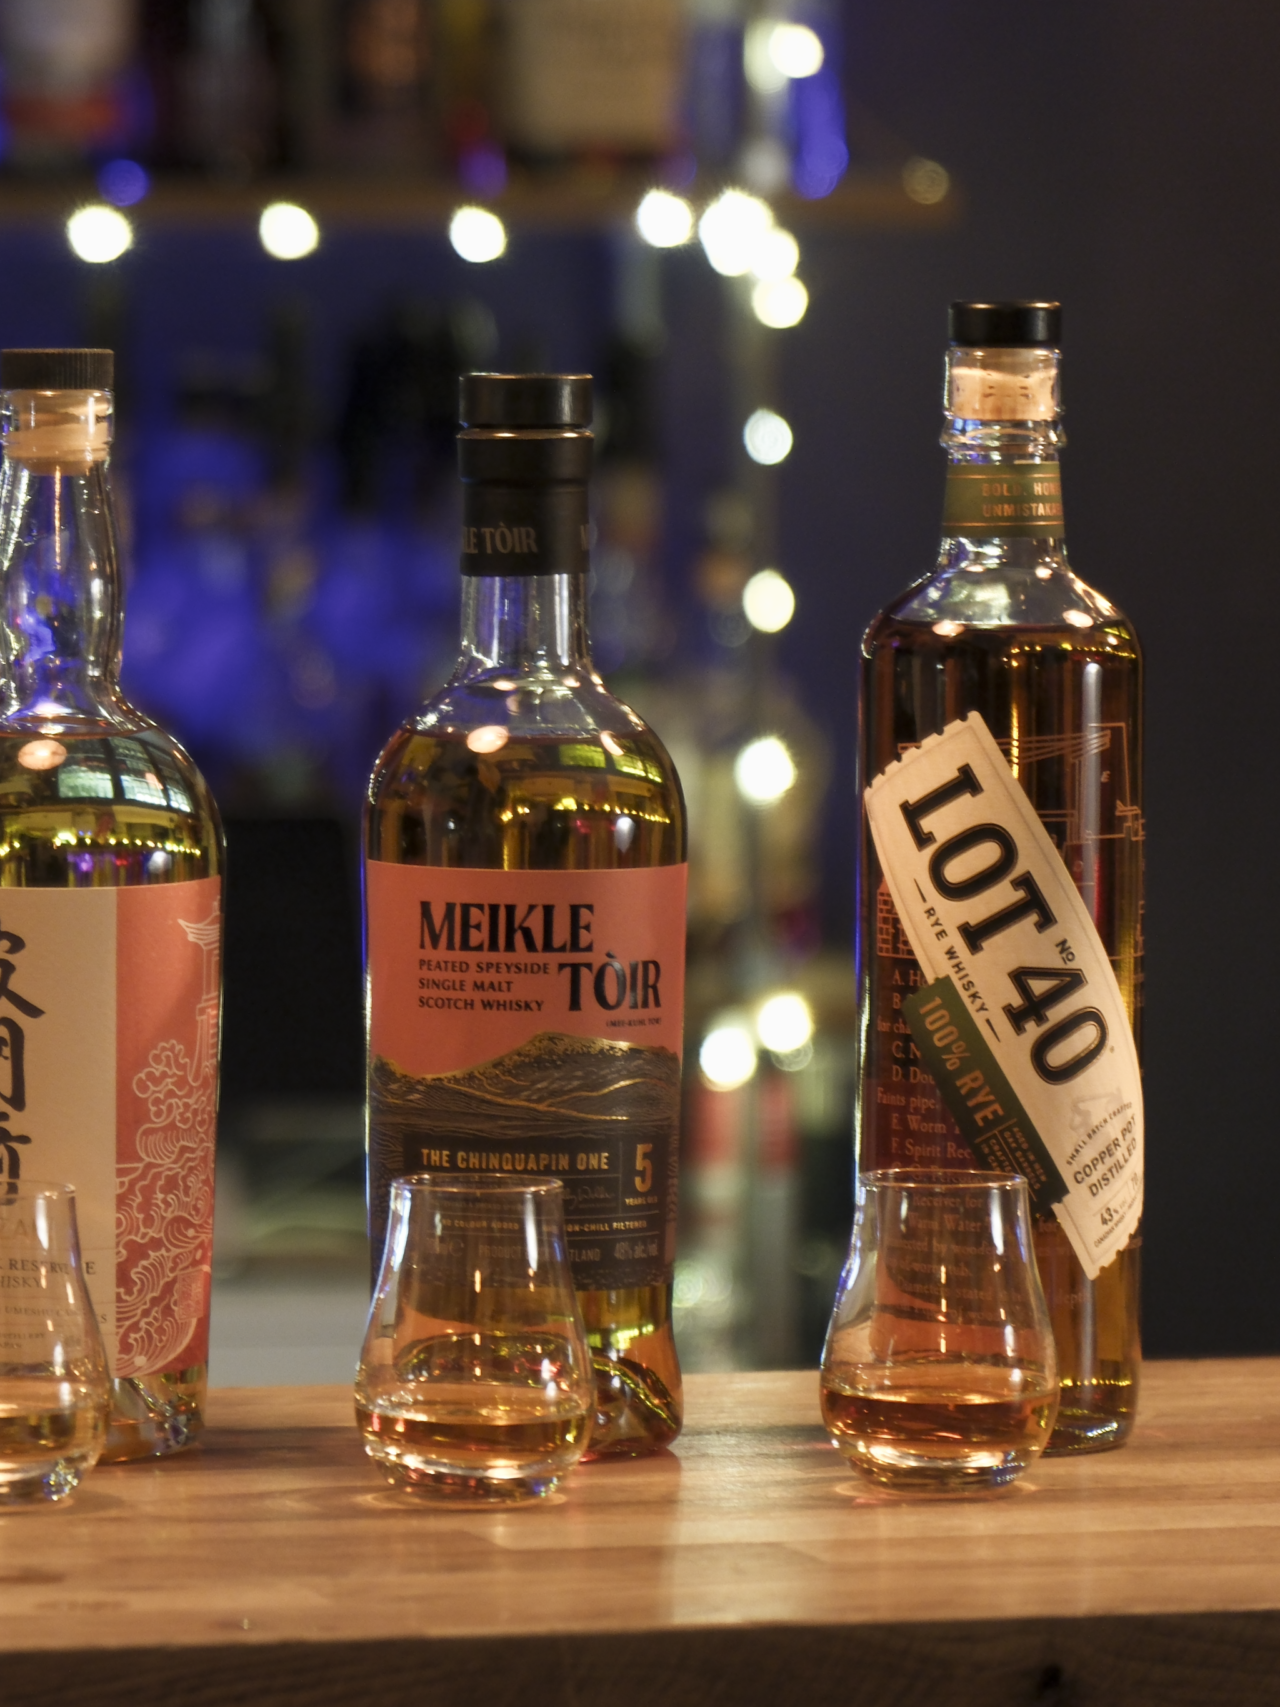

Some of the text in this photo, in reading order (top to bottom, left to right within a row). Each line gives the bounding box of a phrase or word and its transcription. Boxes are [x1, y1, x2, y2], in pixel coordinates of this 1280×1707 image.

[419, 900, 594, 953] MEIKLE
[899, 762, 1058, 955] LOT
[1002, 966, 1109, 1086] 40
[418, 958, 550, 975] PEATED SPEYSIDE
[418, 977, 514, 993] SINGLE MALT
[558, 950, 661, 1012] TÒIR
[924, 906, 989, 1014] RYE WHISKY
[418, 995, 545, 1012] SCOTCH WHISKY
[919, 996, 1004, 1127] 100% RYE
[905, 1139, 941, 1161] Spirit
[907, 1114, 947, 1134] Worm
[1073, 1137, 1122, 1185] COPPER
[1120, 1113, 1137, 1141] POT
[421, 1148, 609, 1171] THE CHINQUAPIN ONE
[634, 1142, 653, 1193] 5
[1088, 1137, 1137, 1197] DISTILLED
